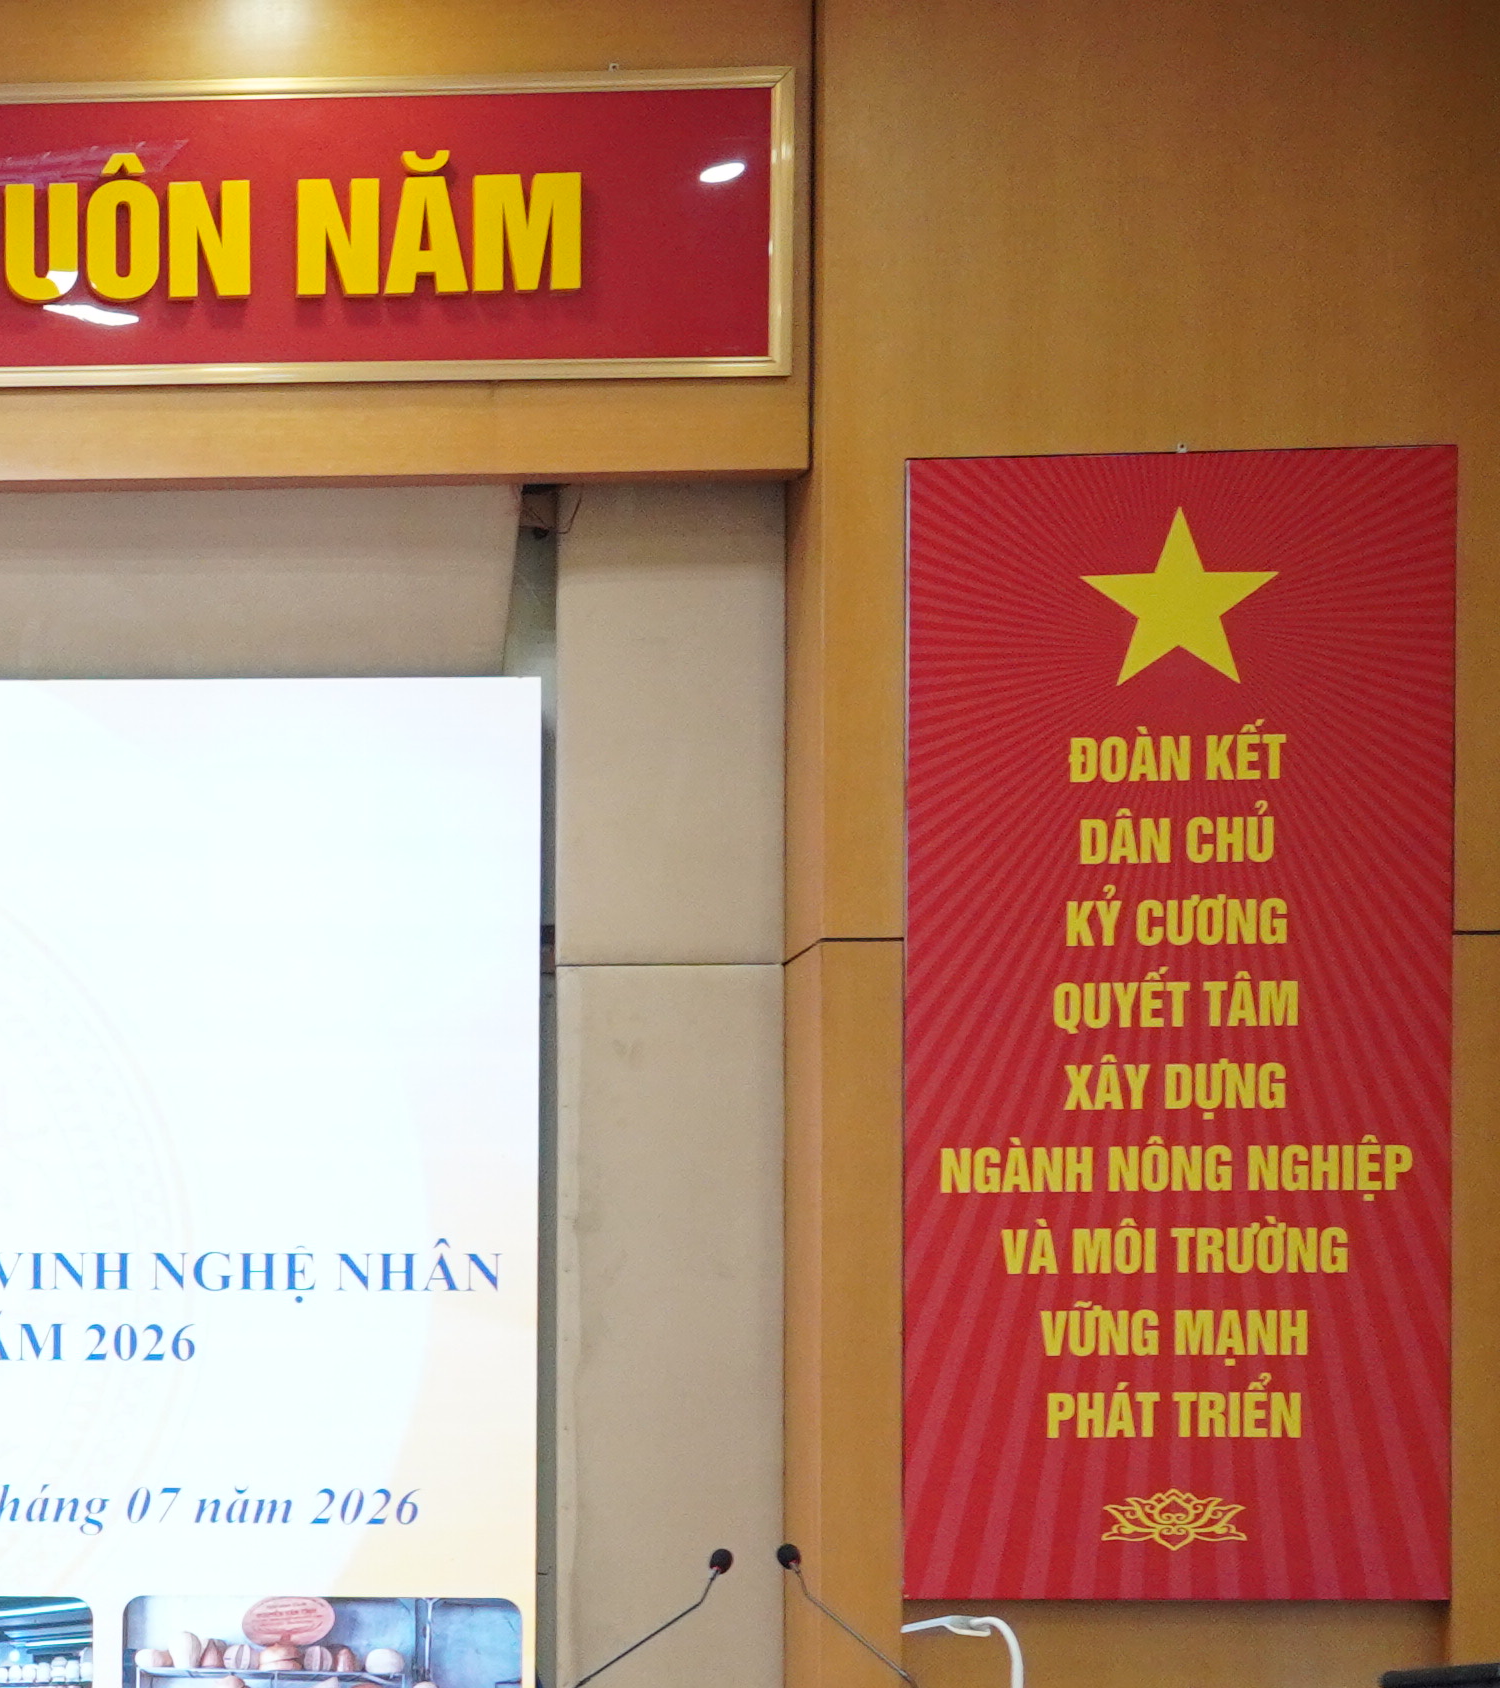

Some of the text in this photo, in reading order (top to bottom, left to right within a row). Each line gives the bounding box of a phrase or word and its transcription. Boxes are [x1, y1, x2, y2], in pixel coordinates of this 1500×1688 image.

[297, 150, 581, 295] NĂM
[1069, 719, 1286, 782] ĐOÀN KẾT
[1081, 801, 1273, 864] DÂN CHỦ
[1067, 885, 1286, 946] KỶ CƯƠNG
[1054, 967, 1298, 1033] QUYẾT TÂM
[1066, 1054, 1285, 1119] XÂY DỰNG
[942, 1135, 1412, 1200] NGÀNH NÔNG NGHIỆP
[152, 1245, 315, 1303] NGHỆ
[336, 1238, 502, 1291] NHÂN
[1003, 1216, 1347, 1274] VÀ MÔI TRƯỜNG
[85, 1323, 195, 1361] 2026
[1042, 1301, 1307, 1365] VỮNG MẠNH
[1048, 1373, 1300, 1438] PHÁT TRIỂN
[127, 1487, 182, 1523] 07
[194, 1487, 292, 1524] năm
[310, 1488, 420, 1525] 2026
